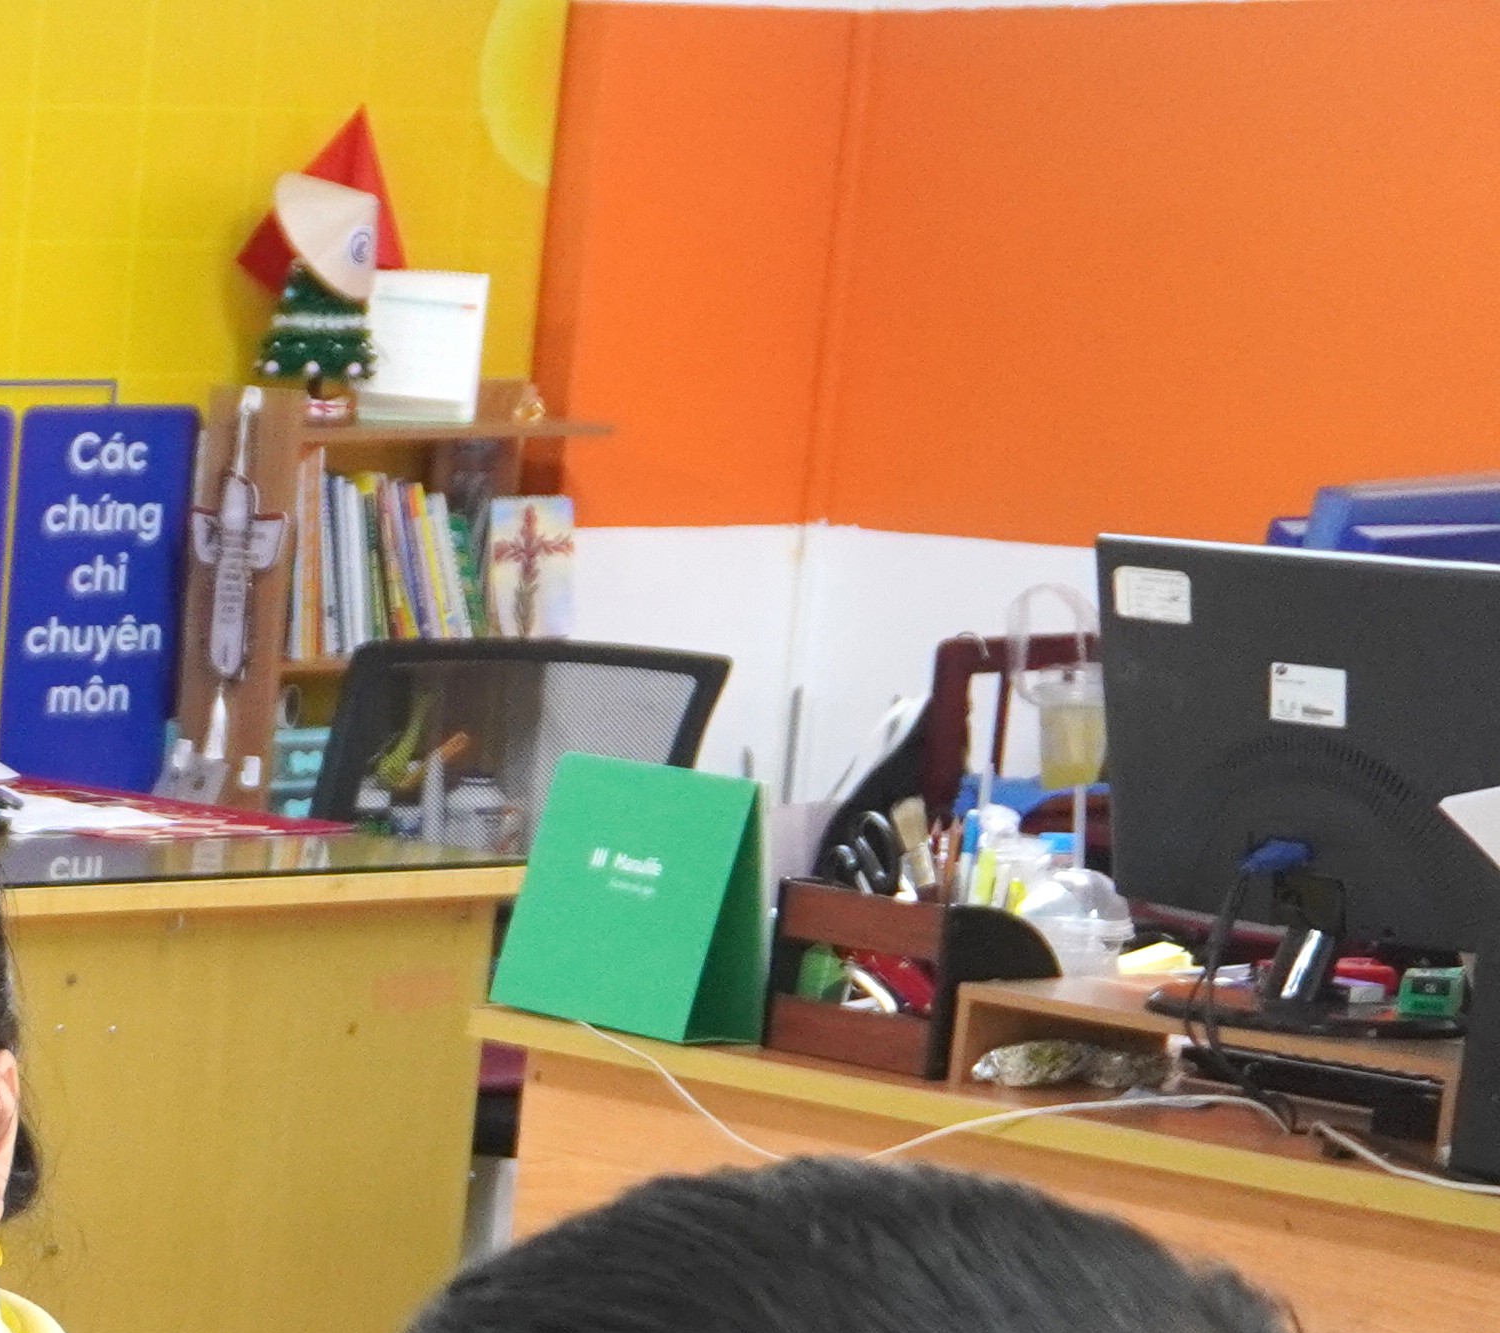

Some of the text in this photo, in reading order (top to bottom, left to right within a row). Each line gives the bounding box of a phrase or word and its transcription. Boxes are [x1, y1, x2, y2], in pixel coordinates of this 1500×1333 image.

[69, 432, 148, 474] Các
[43, 495, 163, 540] chứng
[72, 552, 127, 594] chỉ
[25, 614, 162, 661] chuyên
[47, 676, 130, 714] môn
